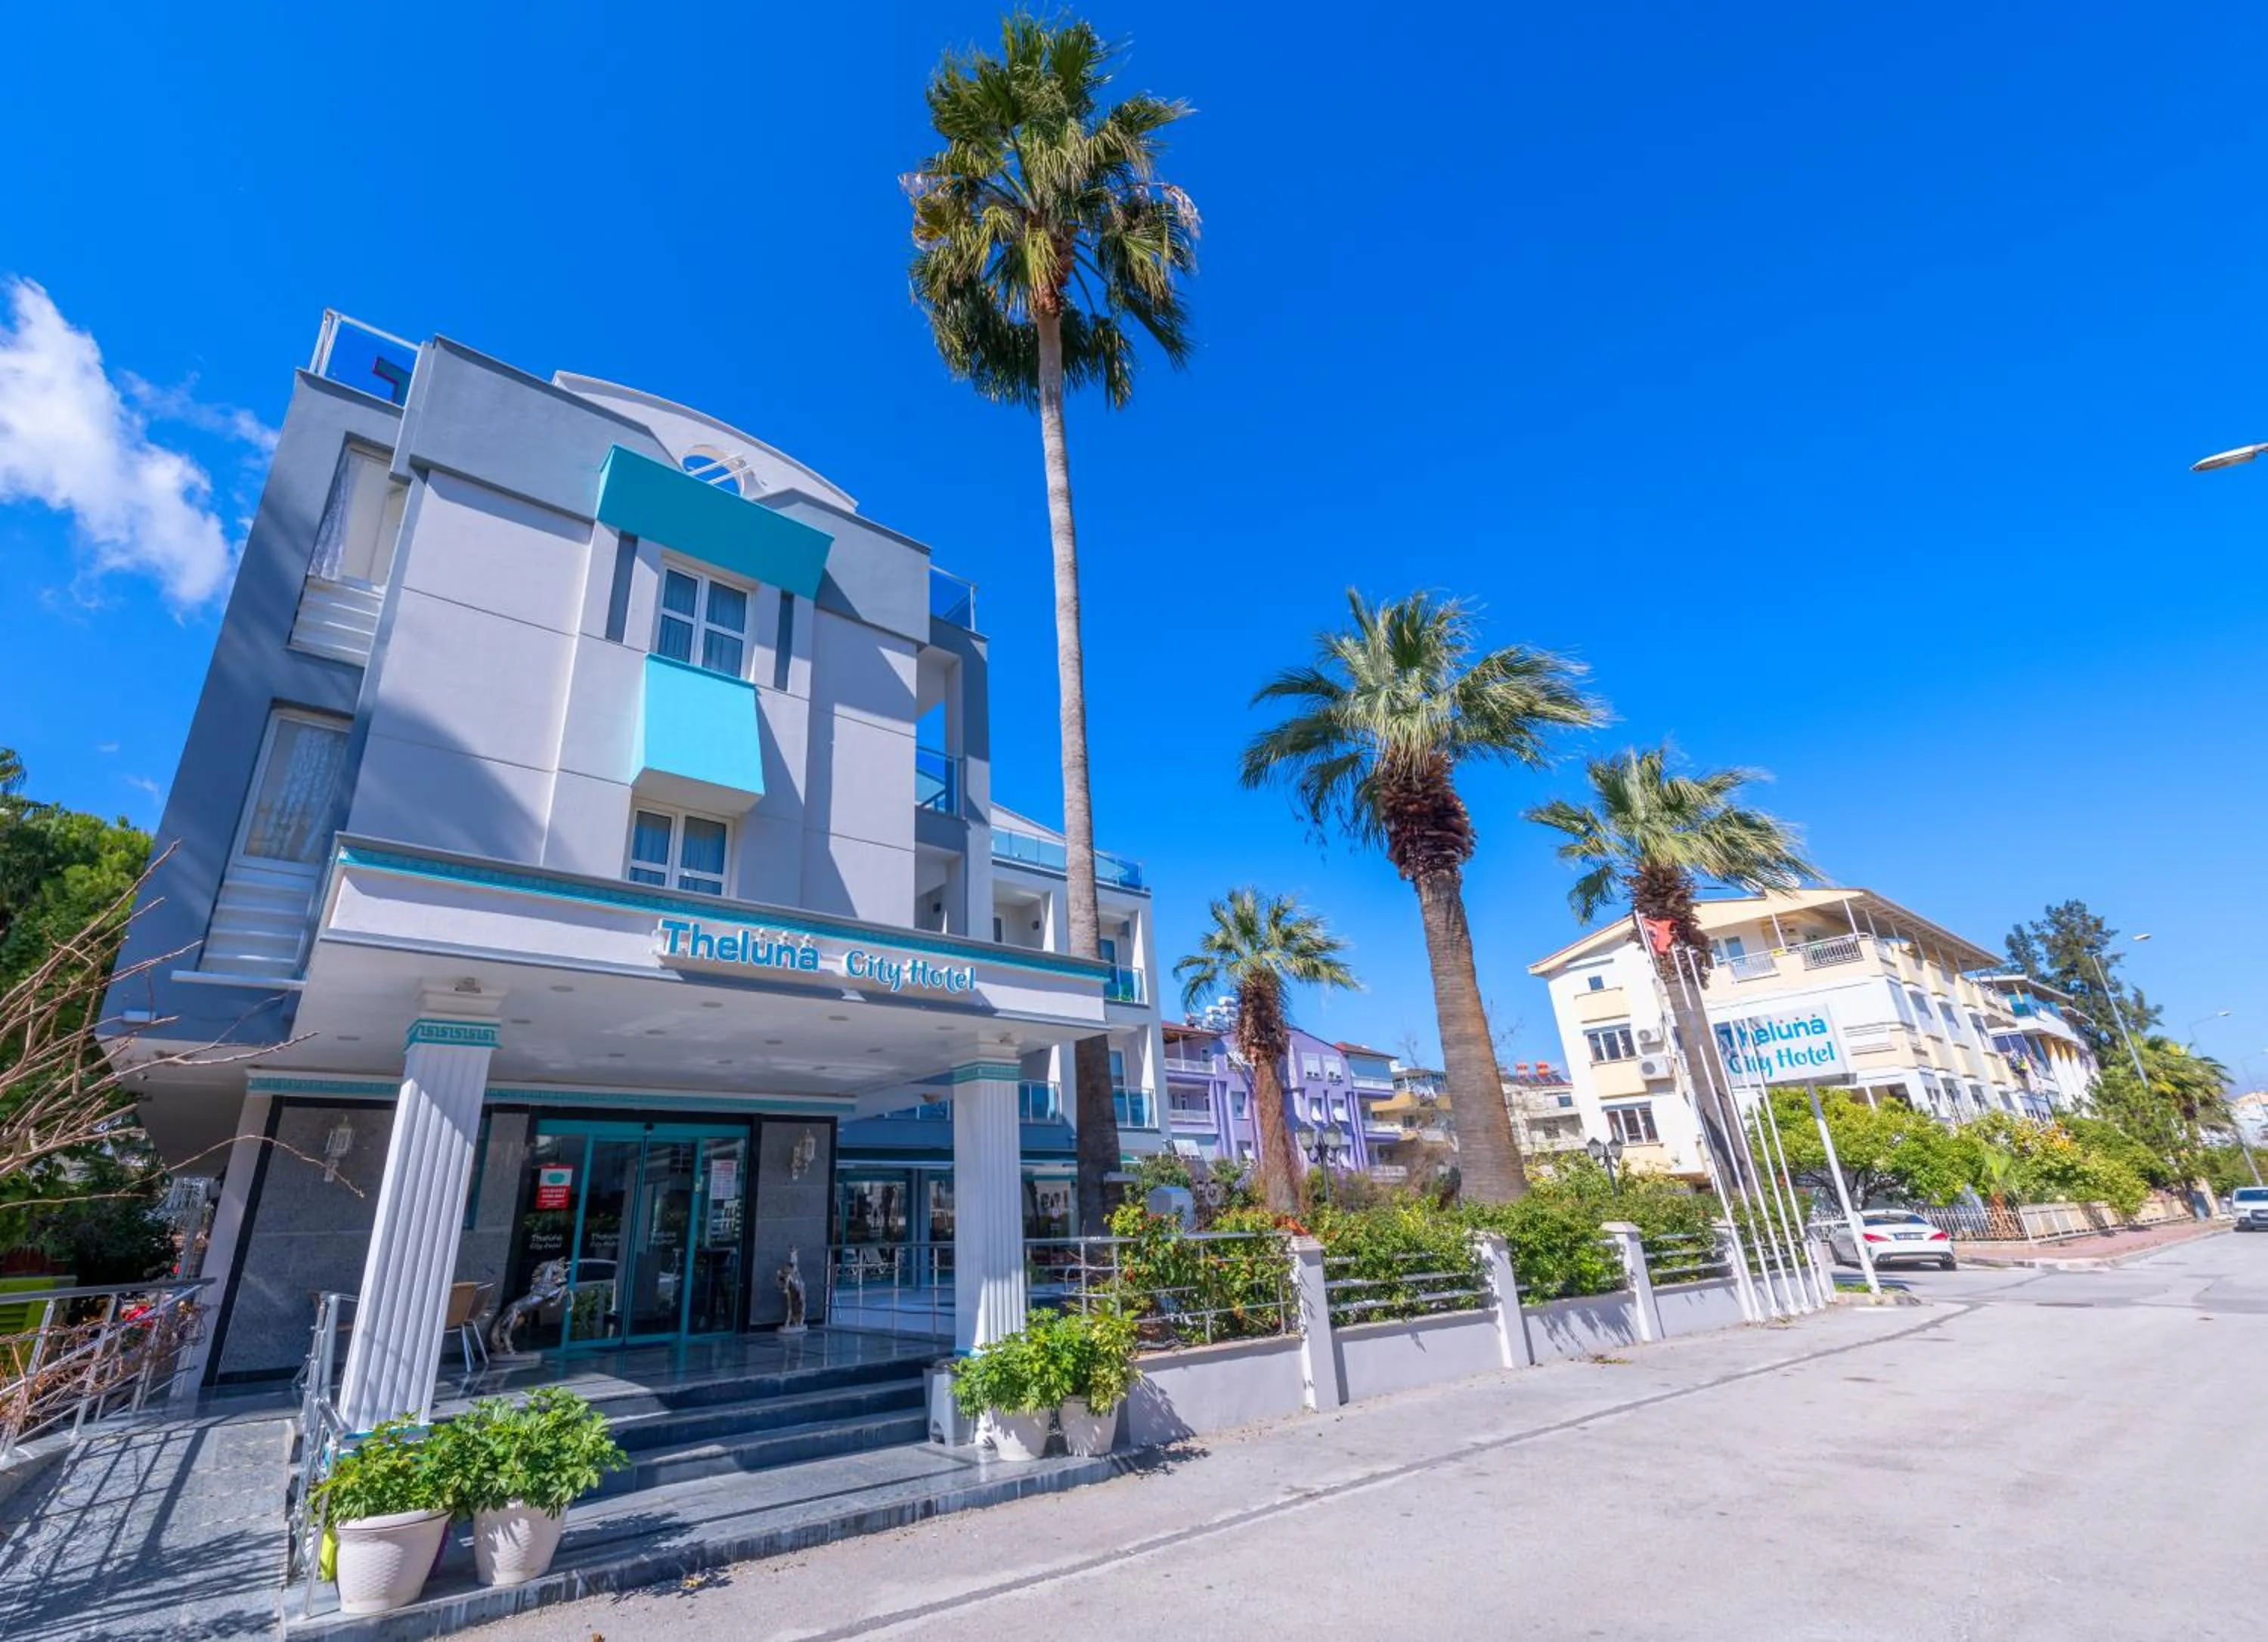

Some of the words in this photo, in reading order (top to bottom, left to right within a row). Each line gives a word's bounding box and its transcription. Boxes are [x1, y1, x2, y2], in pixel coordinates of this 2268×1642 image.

[658, 918, 821, 973] Theluna
[844, 947, 902, 993] City
[906, 958, 976, 993] Hotel
[1777, 1041, 1836, 1069] Hotel
